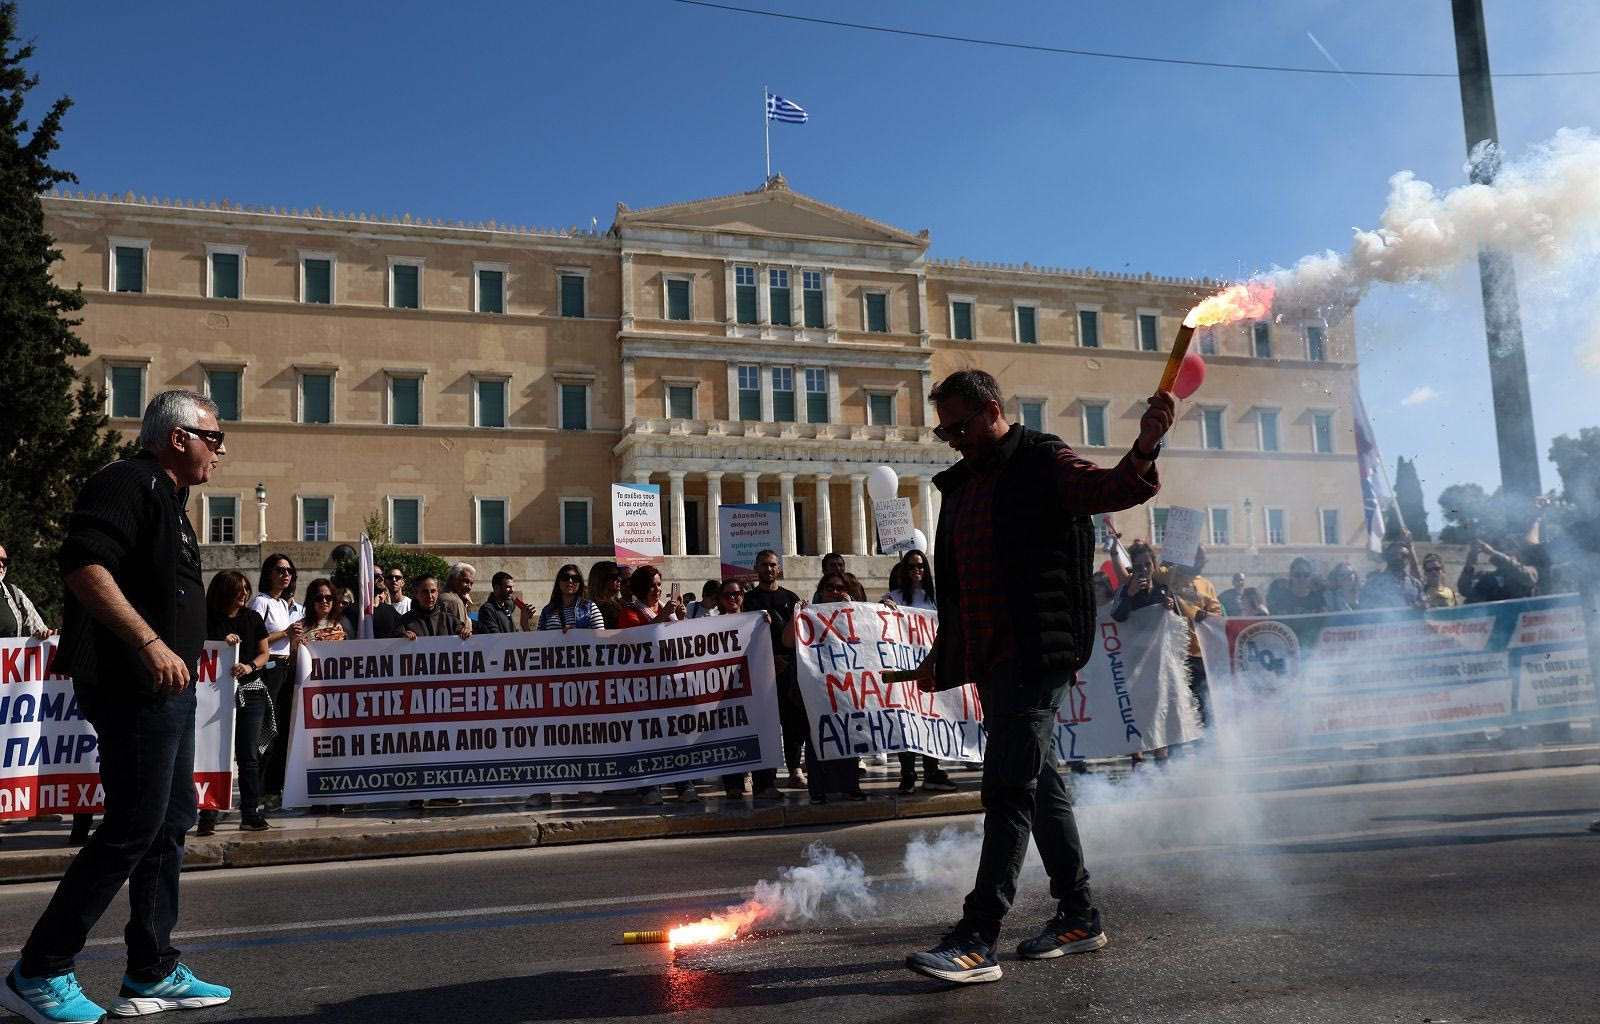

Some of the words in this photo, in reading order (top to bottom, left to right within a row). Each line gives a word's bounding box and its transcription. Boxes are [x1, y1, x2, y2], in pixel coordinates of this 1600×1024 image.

[639, 520, 656, 528] γονείς
[730, 529, 770, 537] φοβισμένος
[795, 608, 861, 646] ΟΧΙ
[876, 610, 937, 645] ΣΤΗΝ
[310, 654, 394, 681] ΔΩΡΕΑΝ
[400, 651, 486, 677] ΠΑΙΔΕΙΑ
[503, 644, 592, 672] ΑΥΞΗΣΕΙΣ
[595, 641, 655, 666] ΣΤΟΥΣ
[659, 629, 742, 663] ΜΙΣΘΟΥΣ
[809, 640, 864, 673] ΤΗΣ
[877, 641, 926, 670] ΕΙΔΙΚ
[311, 692, 350, 720] ΟΧΙ
[355, 689, 405, 718] ΣΤΙΣ
[409, 685, 499, 715] ΔΙΩΞΕΙΣ
[503, 682, 544, 711] ΚΑΙ
[549, 679, 600, 708] ΤΟΥΣ
[604, 663, 744, 705] ΕΚΒΙΑΣΜΟΥΣ
[312, 734, 346, 758] ΕΞΩ
[351, 733, 365, 756] Η
[370, 729, 451, 755] ΕΛΛΑΔΑ
[455, 727, 497, 750] ΑΠΟ
[501, 725, 539, 748] ΤΟΥ
[543, 719, 634, 747] ΠΟΛΕΜΟΥ
[638, 717, 663, 740] ΤΑ
[667, 705, 749, 737] ΣΦΑΓΕΙΑ
[818, 709, 923, 759] ΑΥΞΗΣΕΙΣ
[921, 716, 970, 757] ΣΤΟΥΣ
[3, 734, 100, 768] ΠΛΗΡ
[319, 771, 417, 791] ΣΥΛΛΟΓΟΣ
[423, 763, 582, 785] ΕΚΠΑΙΔΕΥΤΙΚΩΝ
[587, 761, 622, 777] Π.Ε.
[628, 746, 747, 774] «Γ.ΣΕΦΕΡΗΣ»
[40, 784, 70, 808] ΠΕ
